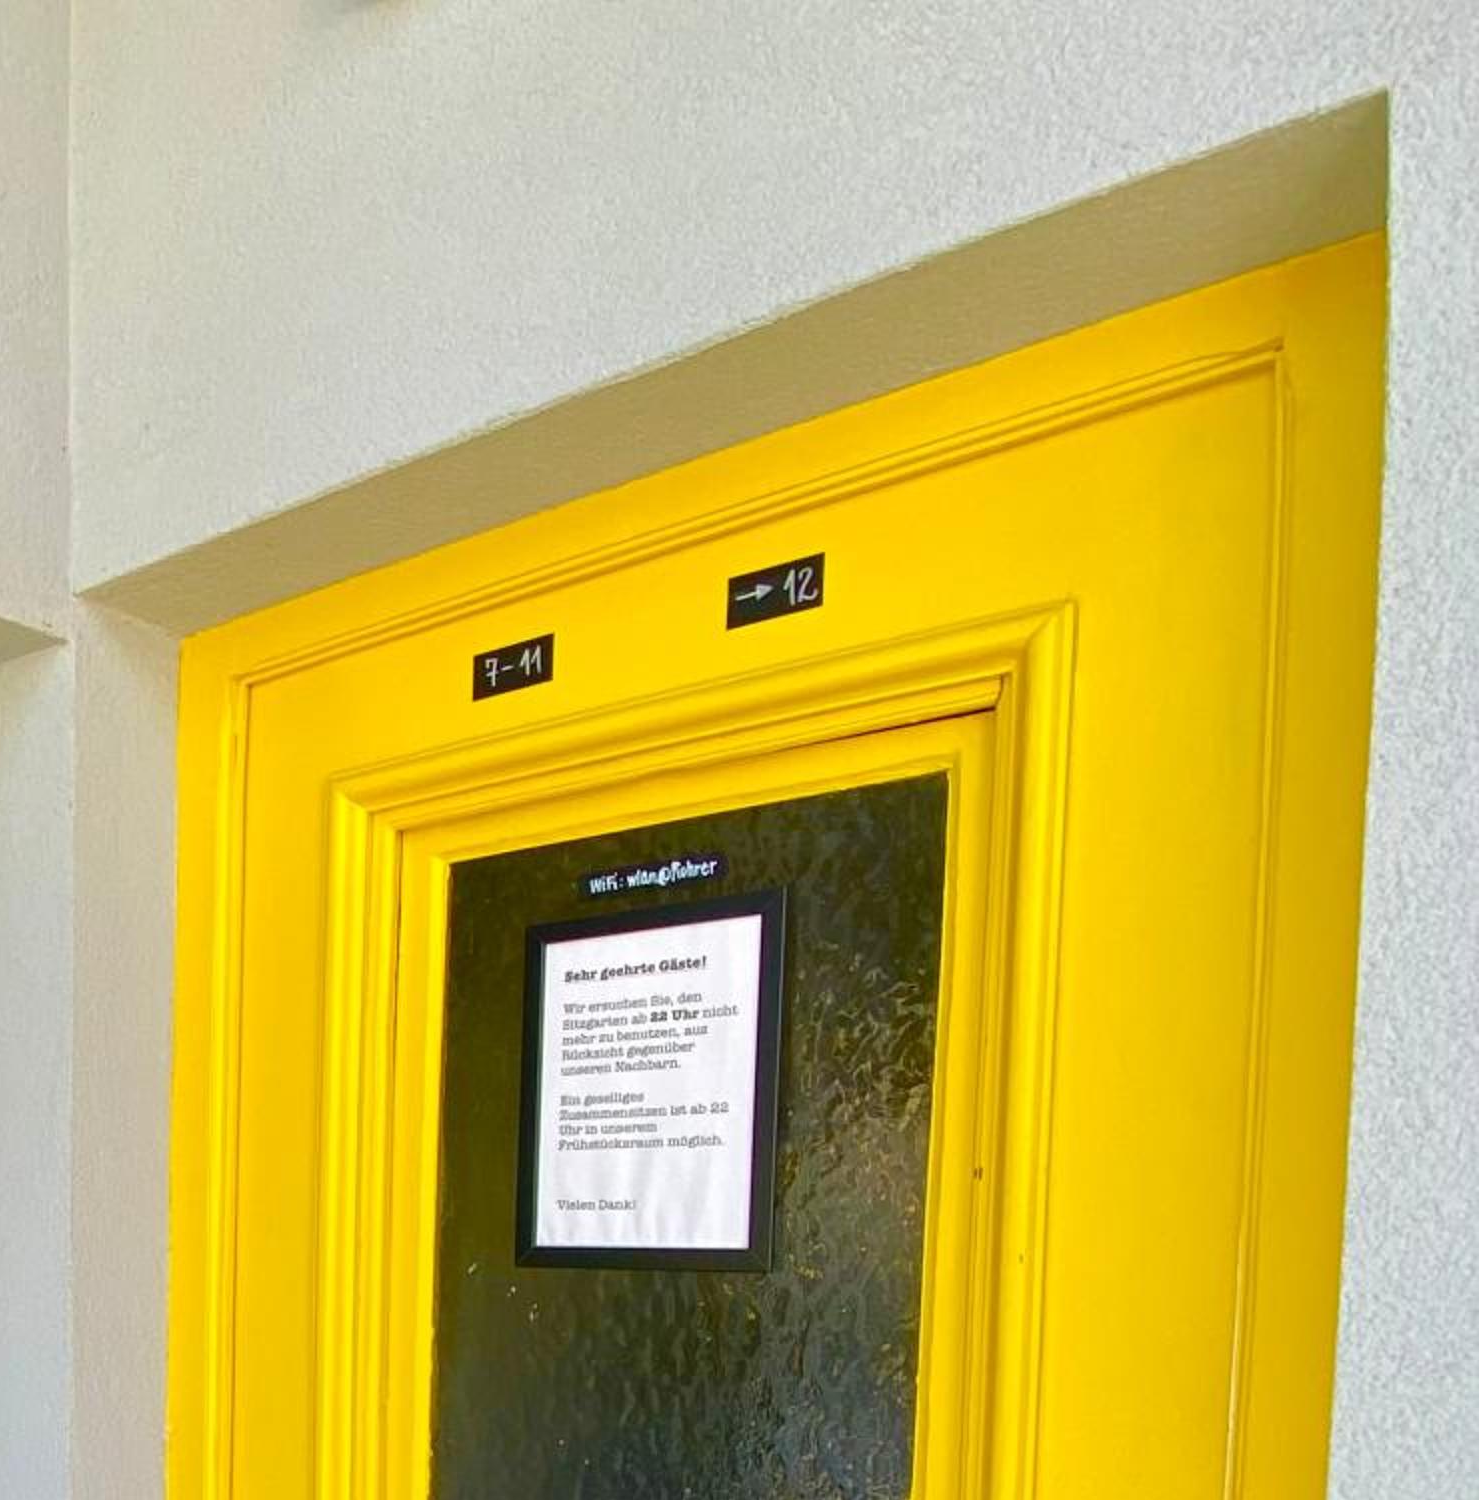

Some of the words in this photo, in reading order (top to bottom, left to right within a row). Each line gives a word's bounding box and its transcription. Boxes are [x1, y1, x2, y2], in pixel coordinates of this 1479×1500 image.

[783, 566, 819, 607] 12
[564, 967, 598, 983] Sehr
[600, 961, 656, 982] geehrte
[658, 955, 708, 972] Gäste!
[563, 1002, 586, 1014] Wir
[588, 997, 648, 1012] ersuchen
[676, 991, 702, 1004] den
[631, 1013, 647, 1024] ab
[650, 1010, 668, 1022] 22
[671, 1008, 699, 1021] Uhr
[702, 1004, 739, 1019] nicht
[562, 1033, 596, 1046] mehr
[598, 1031, 614, 1043] zu
[683, 1024, 708, 1036] aus
[626, 1041, 696, 1059] gegenüber
[560, 1063, 612, 1076] unseren
[614, 1058, 681, 1073] Nachbarn.
[560, 1094, 581, 1106] Ein
[670, 1104, 687, 1116] ist
[690, 1103, 707, 1115] ab
[710, 1102, 730, 1114] 22
[559, 1123, 583, 1136] Uhr
[585, 1123, 598, 1135] in
[600, 1122, 658, 1134] unserem
[556, 1199, 596, 1210] Vielen
[598, 1199, 637, 1210] Dank!
